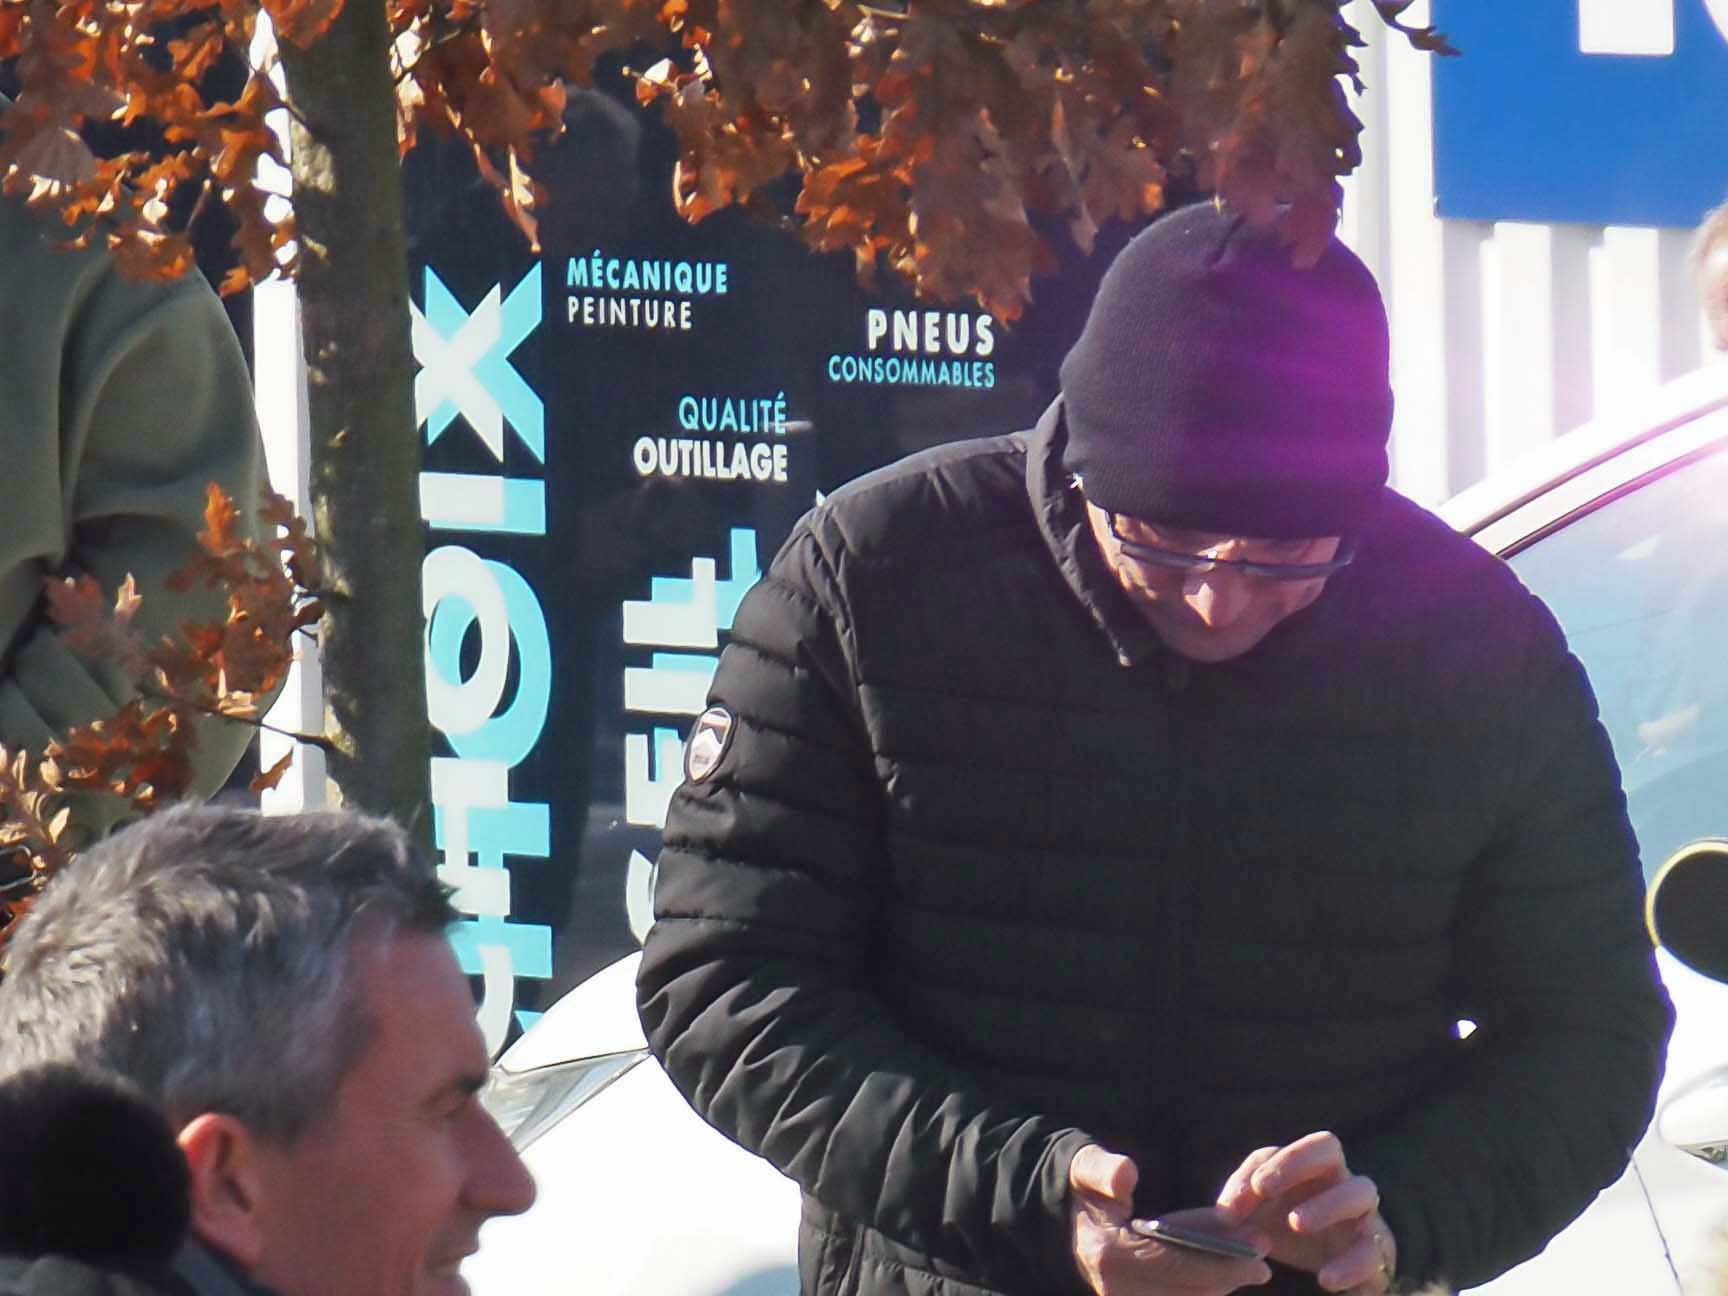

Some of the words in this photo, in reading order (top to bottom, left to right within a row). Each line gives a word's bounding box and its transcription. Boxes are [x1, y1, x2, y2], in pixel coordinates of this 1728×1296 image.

[566, 248, 728, 294] MÉCANIQUE
[566, 295, 693, 330] PEINTURE
[866, 308, 996, 356] PNEUS
[828, 354, 996, 388] CONSOMMABLES
[678, 391, 787, 436] QUALITÉ
[633, 436, 789, 481] OUTILLAGE
